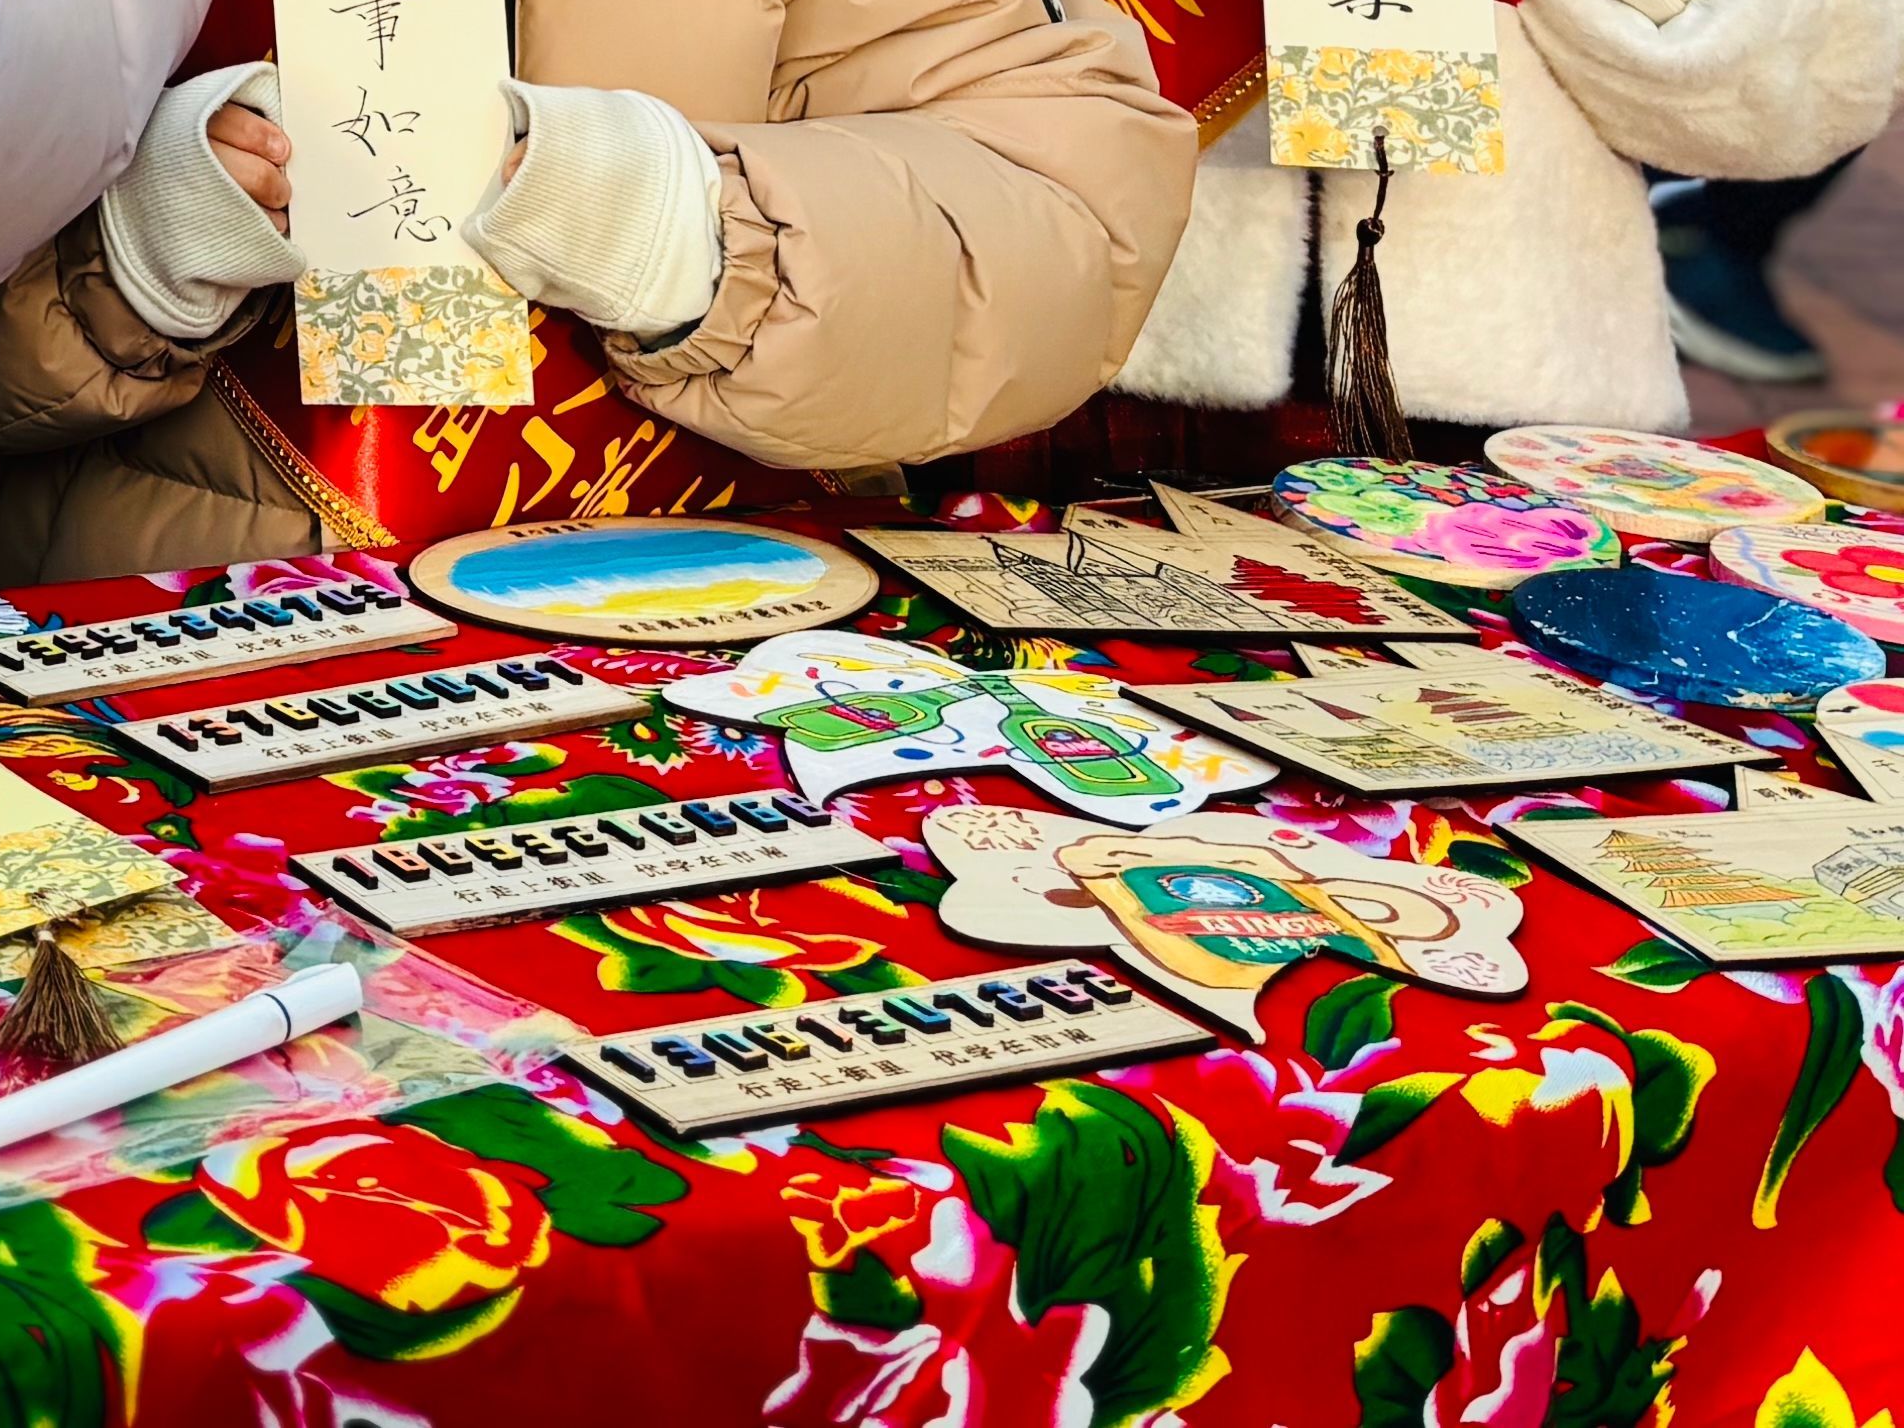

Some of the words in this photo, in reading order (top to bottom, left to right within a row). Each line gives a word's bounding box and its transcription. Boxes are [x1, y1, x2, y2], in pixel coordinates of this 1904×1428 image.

[635, 846, 789, 879] 优学在市南
[738, 1061, 910, 1101] 行走上街里
[929, 1028, 1098, 1068] 优学在市南
